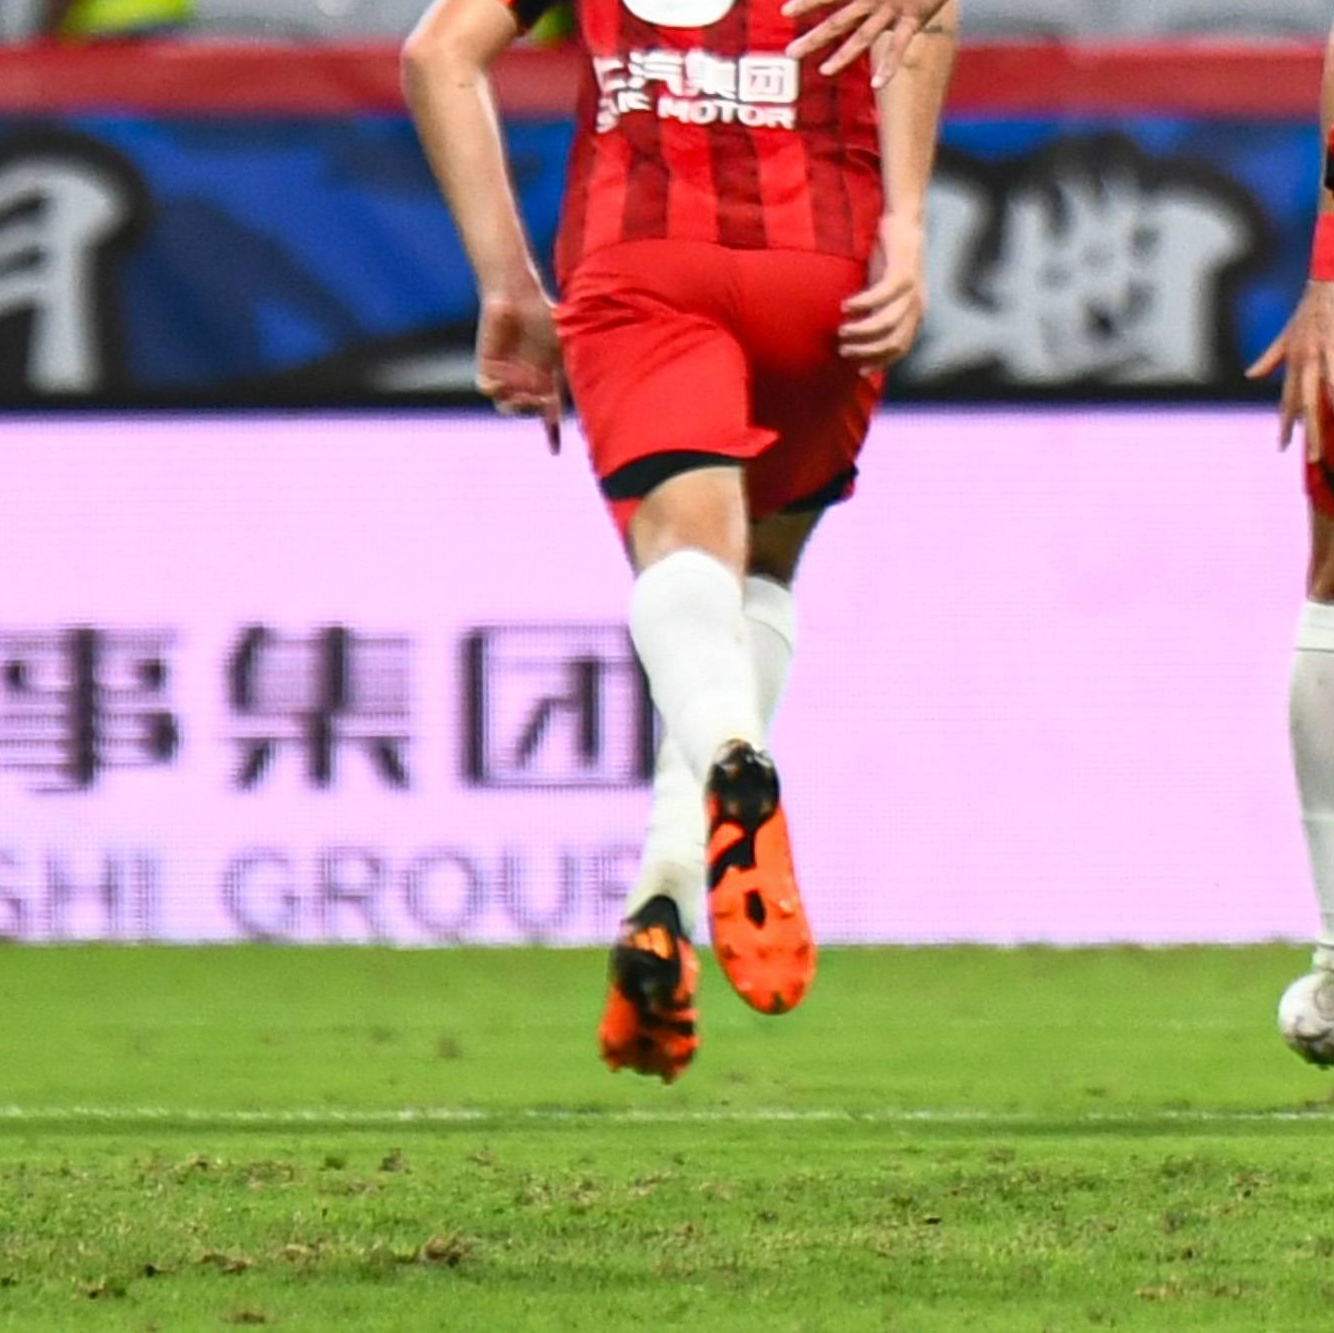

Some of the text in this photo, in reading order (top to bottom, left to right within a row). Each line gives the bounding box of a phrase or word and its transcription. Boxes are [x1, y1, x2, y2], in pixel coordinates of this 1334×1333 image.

[593, 48, 799, 104] 上汽集团
[657, 97, 797, 130] MOTOR
